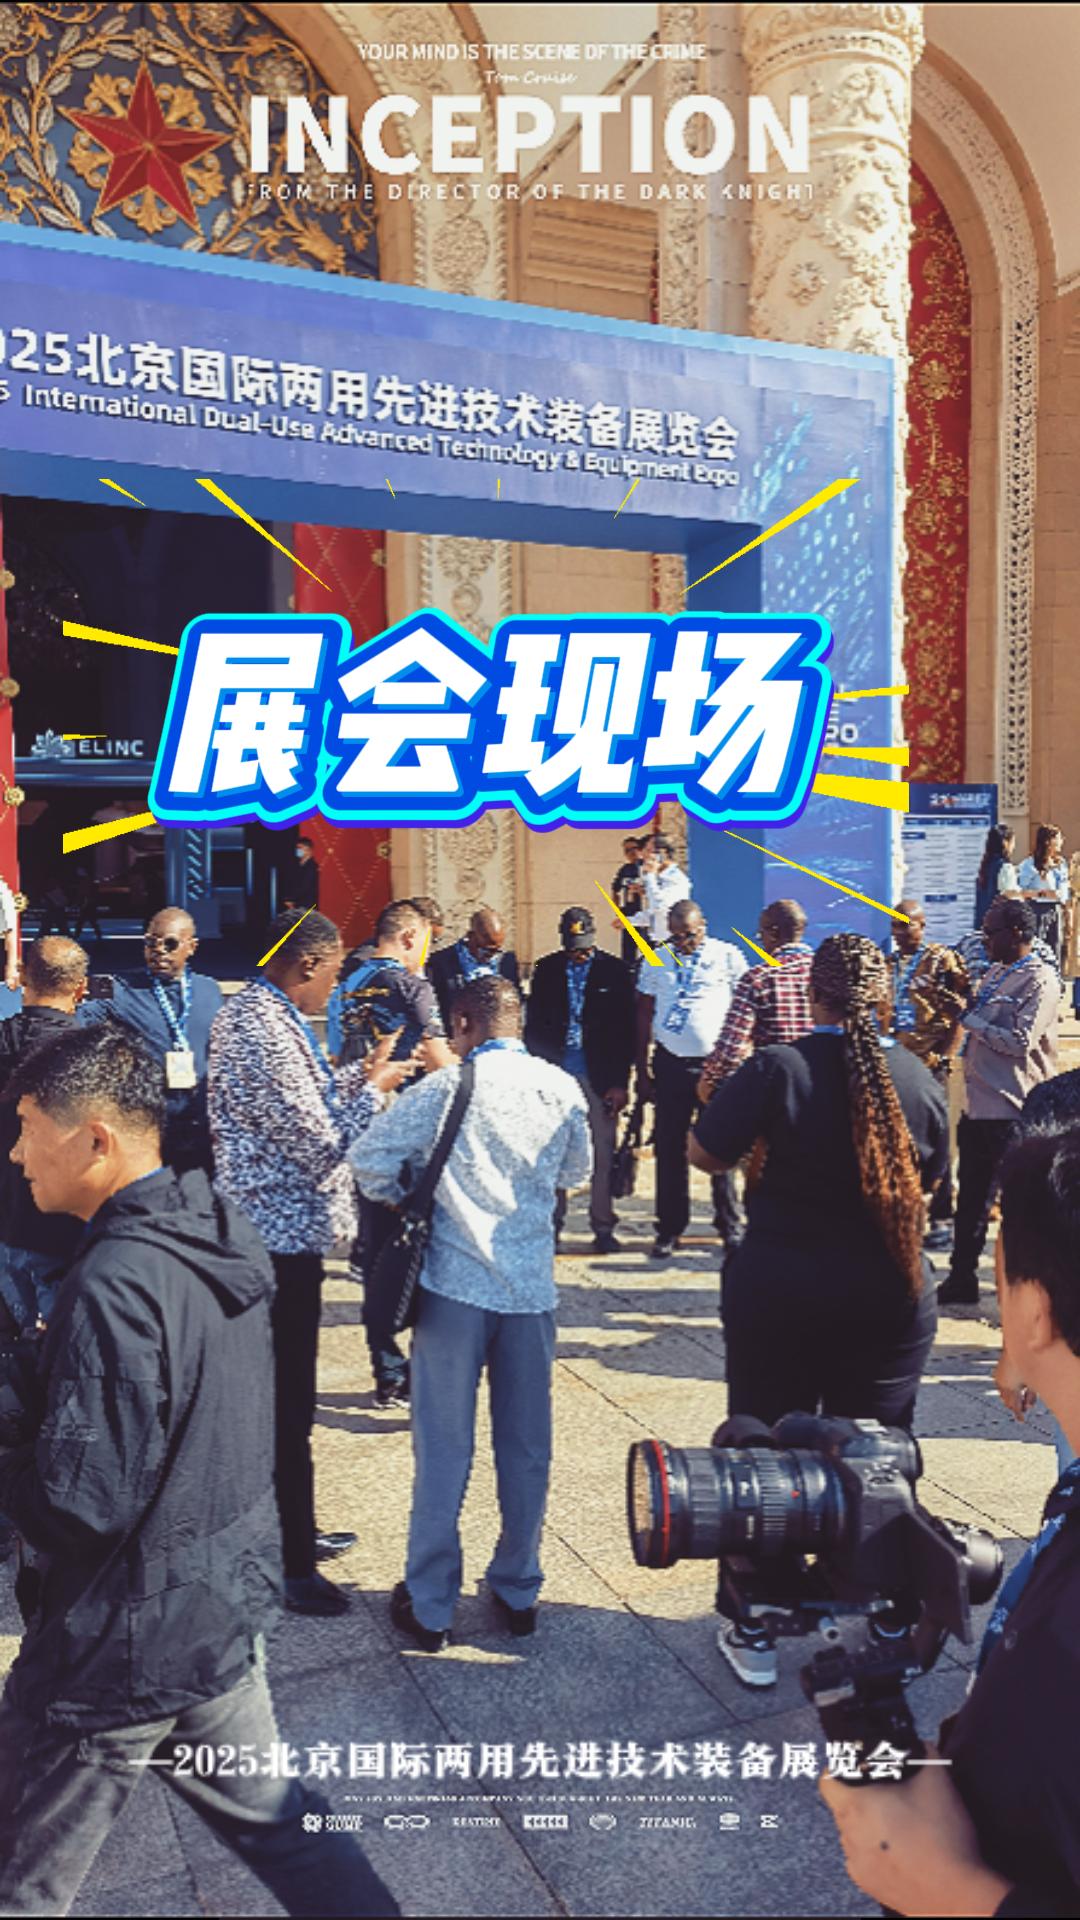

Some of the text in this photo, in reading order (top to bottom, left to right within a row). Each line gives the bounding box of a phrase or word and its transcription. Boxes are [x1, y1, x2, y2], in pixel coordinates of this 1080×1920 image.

[0, 327, 739, 461] 25北京国际两用先进技术装备展览会
[25, 383, 197, 425] International
[203, 406, 315, 440] Dual-Use
[320, 421, 432, 452] Advanced
[438, 435, 563, 471] Technology
[565, 455, 580, 470] &
[583, 451, 690, 480] Equipment
[693, 463, 739, 486] Expo
